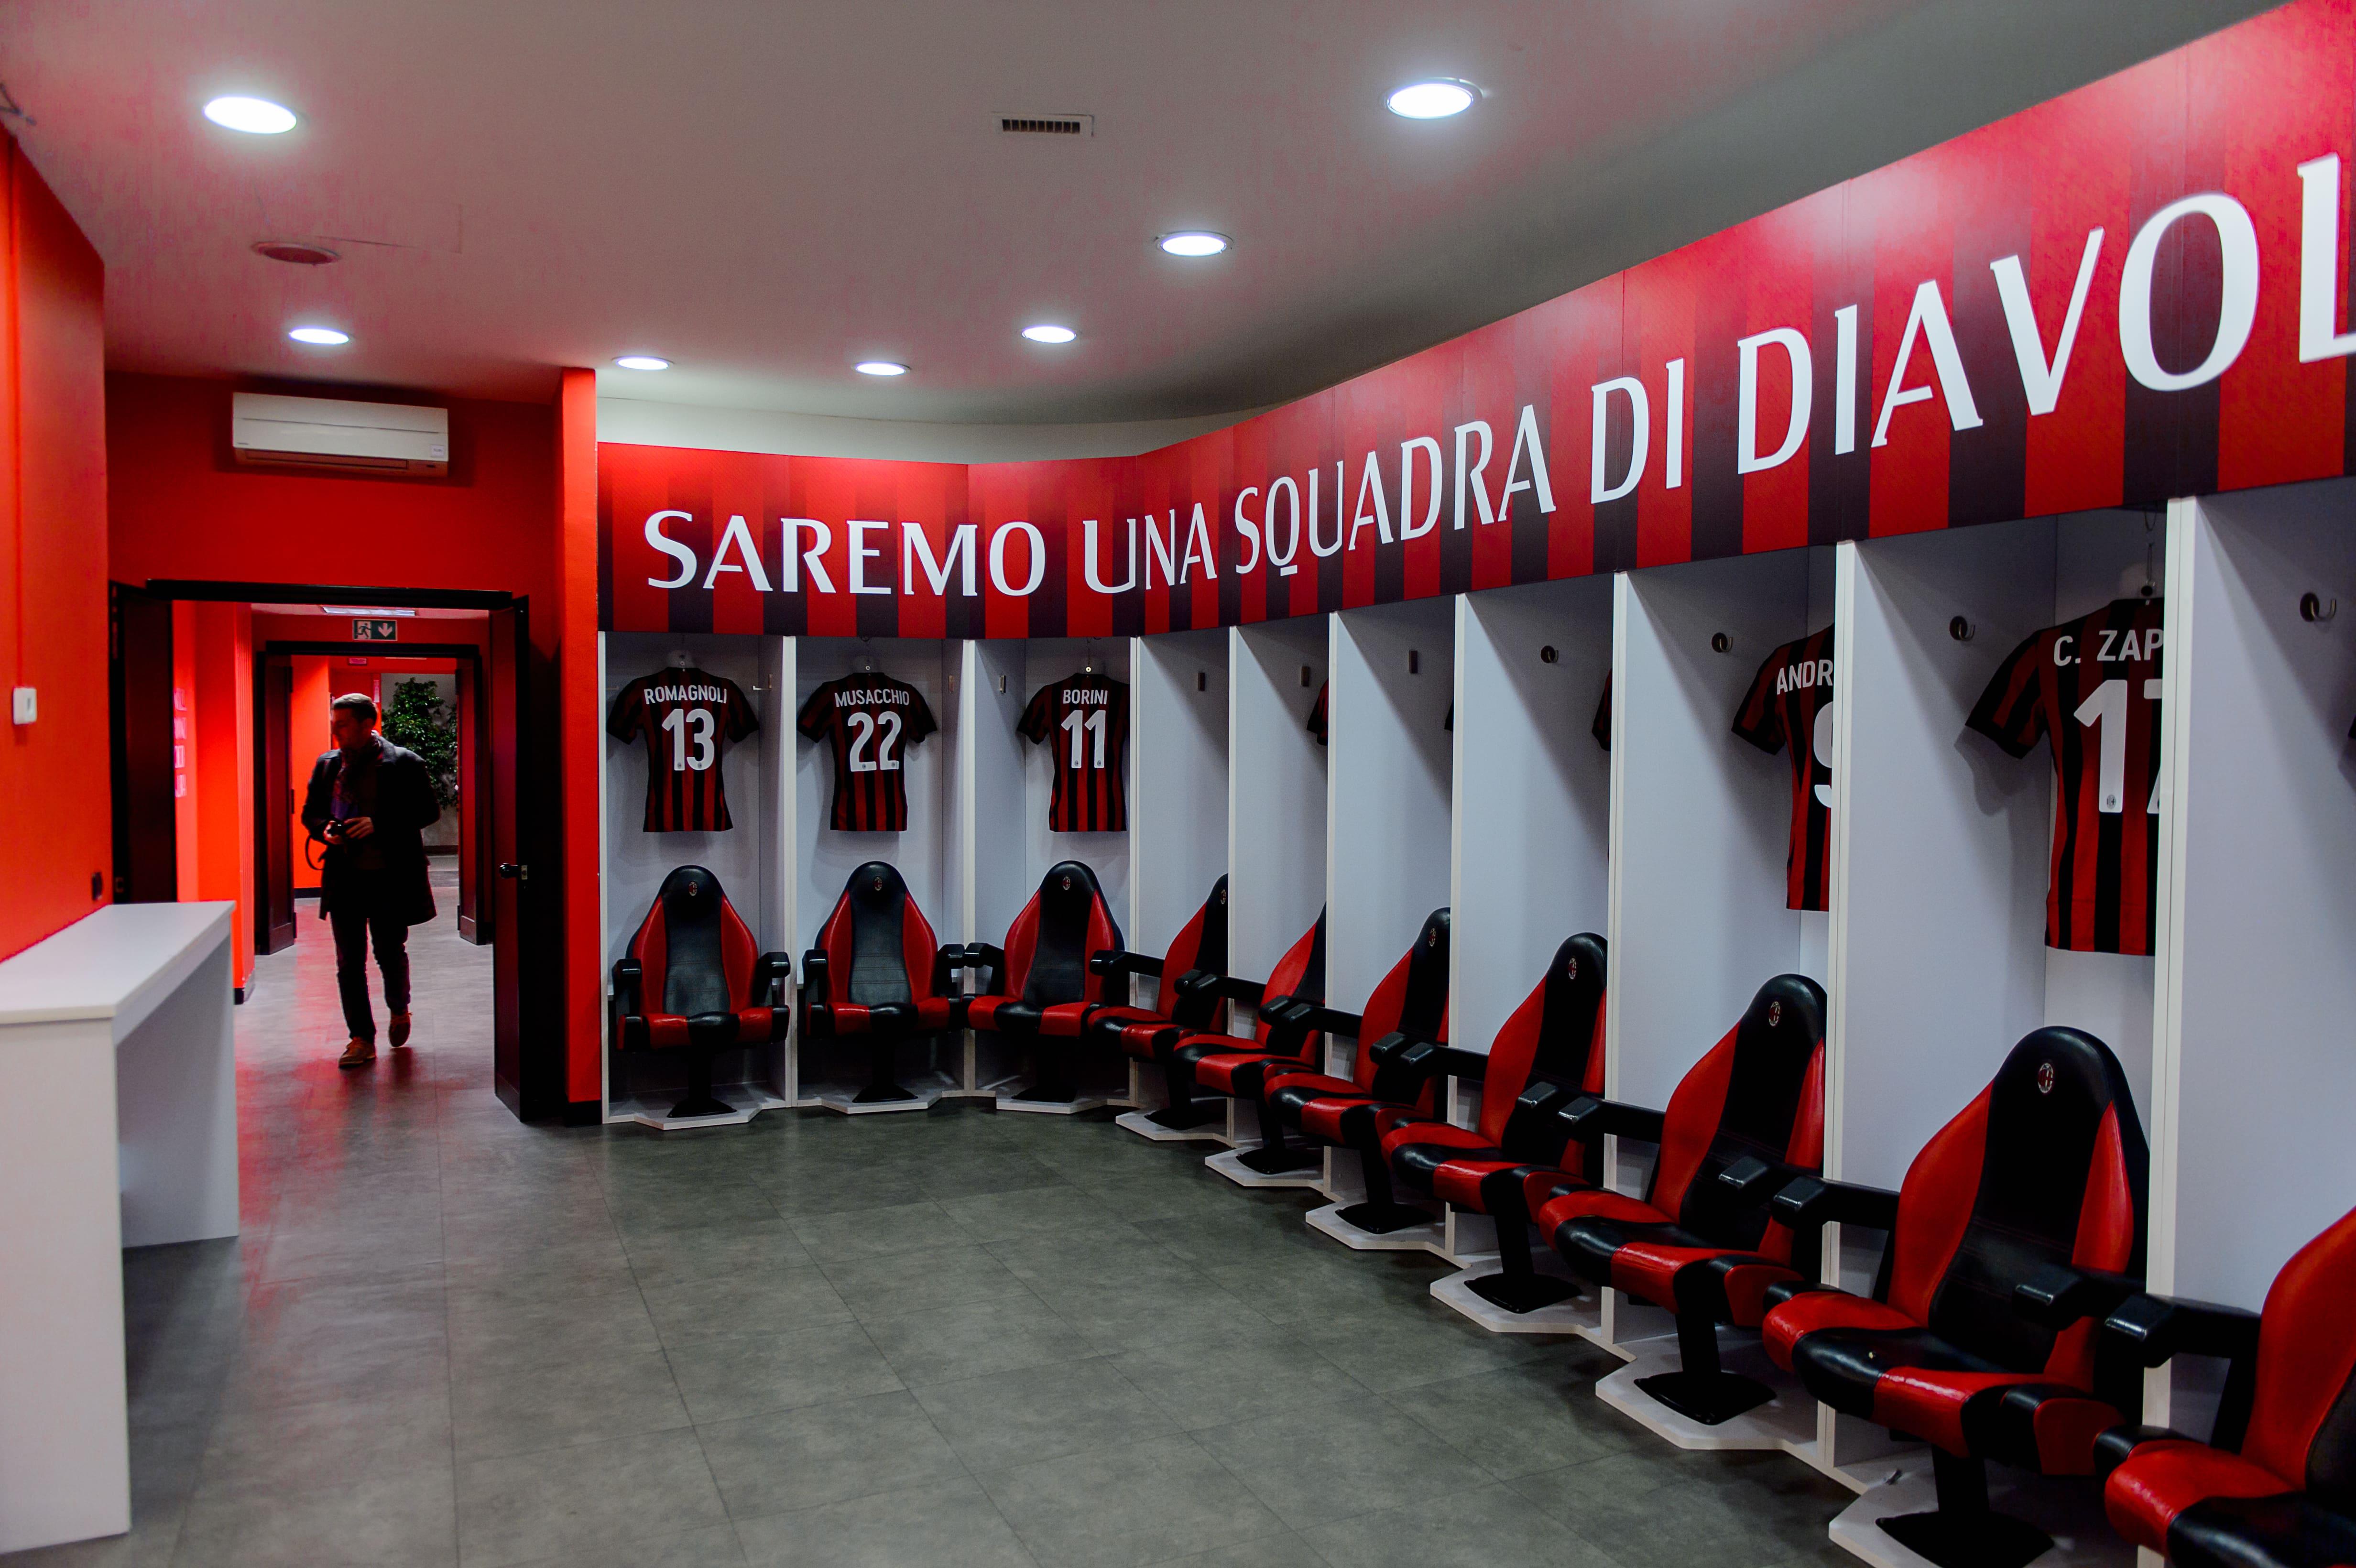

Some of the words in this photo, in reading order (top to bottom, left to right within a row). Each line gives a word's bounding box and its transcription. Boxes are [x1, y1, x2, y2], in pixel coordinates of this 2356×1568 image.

[644, 510, 1046, 597] SAREMO
[1082, 502, 1218, 594] UNA
[1234, 403, 1557, 577] SQUADRA
[1590, 357, 1684, 504] DI
[2053, 635, 2081, 666] C.
[644, 685, 727, 705] ROMAGNOLI
[1776, 659, 1833, 696] ANDR
[834, 688, 910, 708] MUSACCHIO
[1062, 689, 1108, 705] BORINI
[661, 708, 715, 771] 13
[847, 710, 901, 772] 22
[1060, 709, 1107, 769] 11
